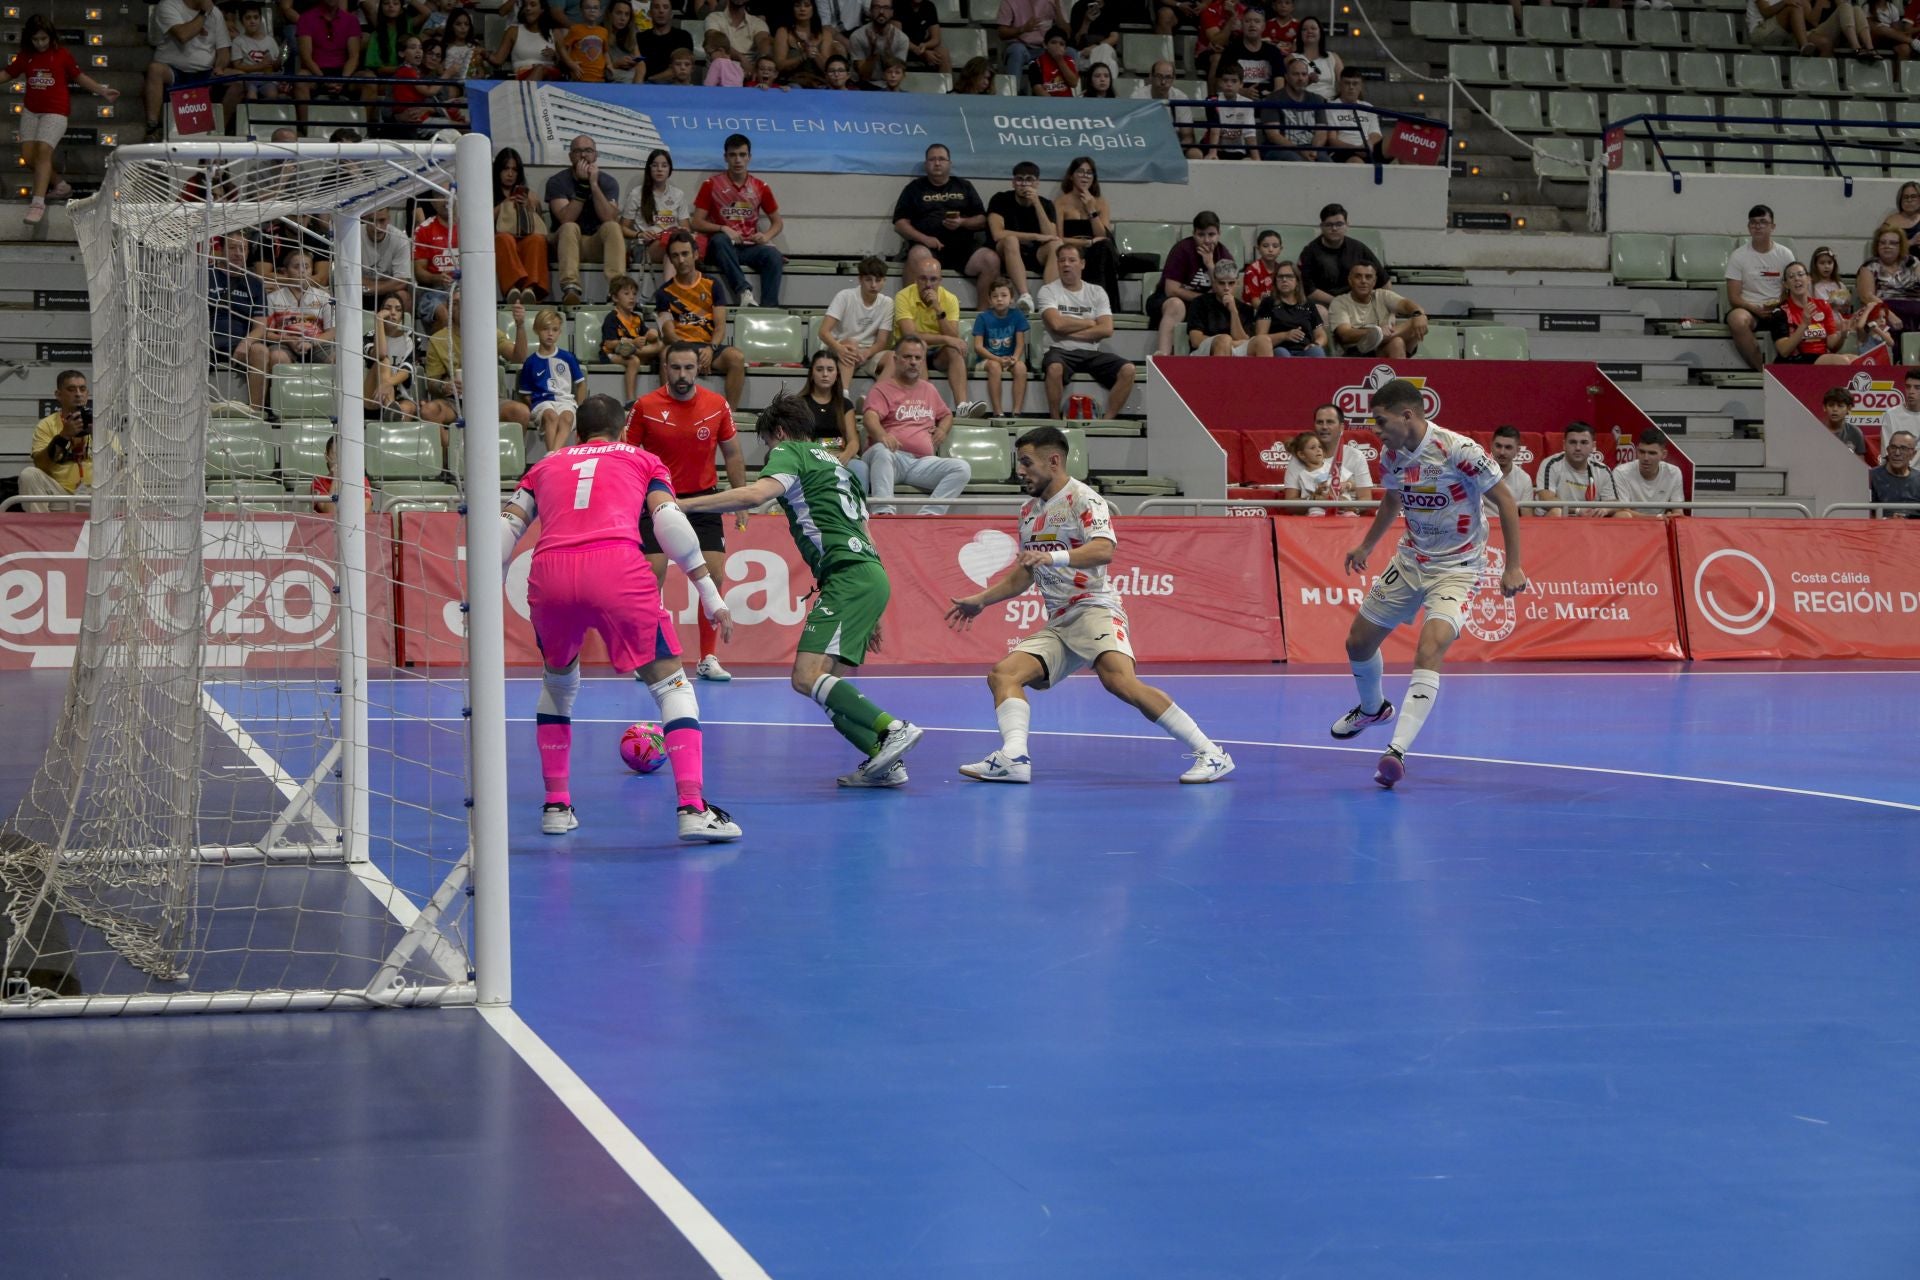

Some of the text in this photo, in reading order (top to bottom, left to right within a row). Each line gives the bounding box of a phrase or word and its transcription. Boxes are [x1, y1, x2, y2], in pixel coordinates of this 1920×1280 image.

[178, 103, 208, 115] MÓDULO
[192, 116, 198, 125] 1
[667, 115, 928, 137] TU HOTEL EN MURCIA
[993, 115, 1116, 130] Occidental
[998, 132, 1147, 151] Murcia Agalia
[1400, 131, 1437, 150] MÓDULO
[1412, 147, 1419, 156] 1
[923, 192, 965, 202] adidas
[567, 443, 636, 455] HERRERO
[570, 457, 600, 511] 1
[1380, 564, 1400, 586] 10
[1791, 571, 1872, 584] Costa Cálida
[1301, 587, 1364, 605] MUR
[1522, 577, 1659, 599] Ayuntamiento
[1793, 587, 1894, 614] REGIÓN
[1525, 602, 1631, 621] de Murcia
